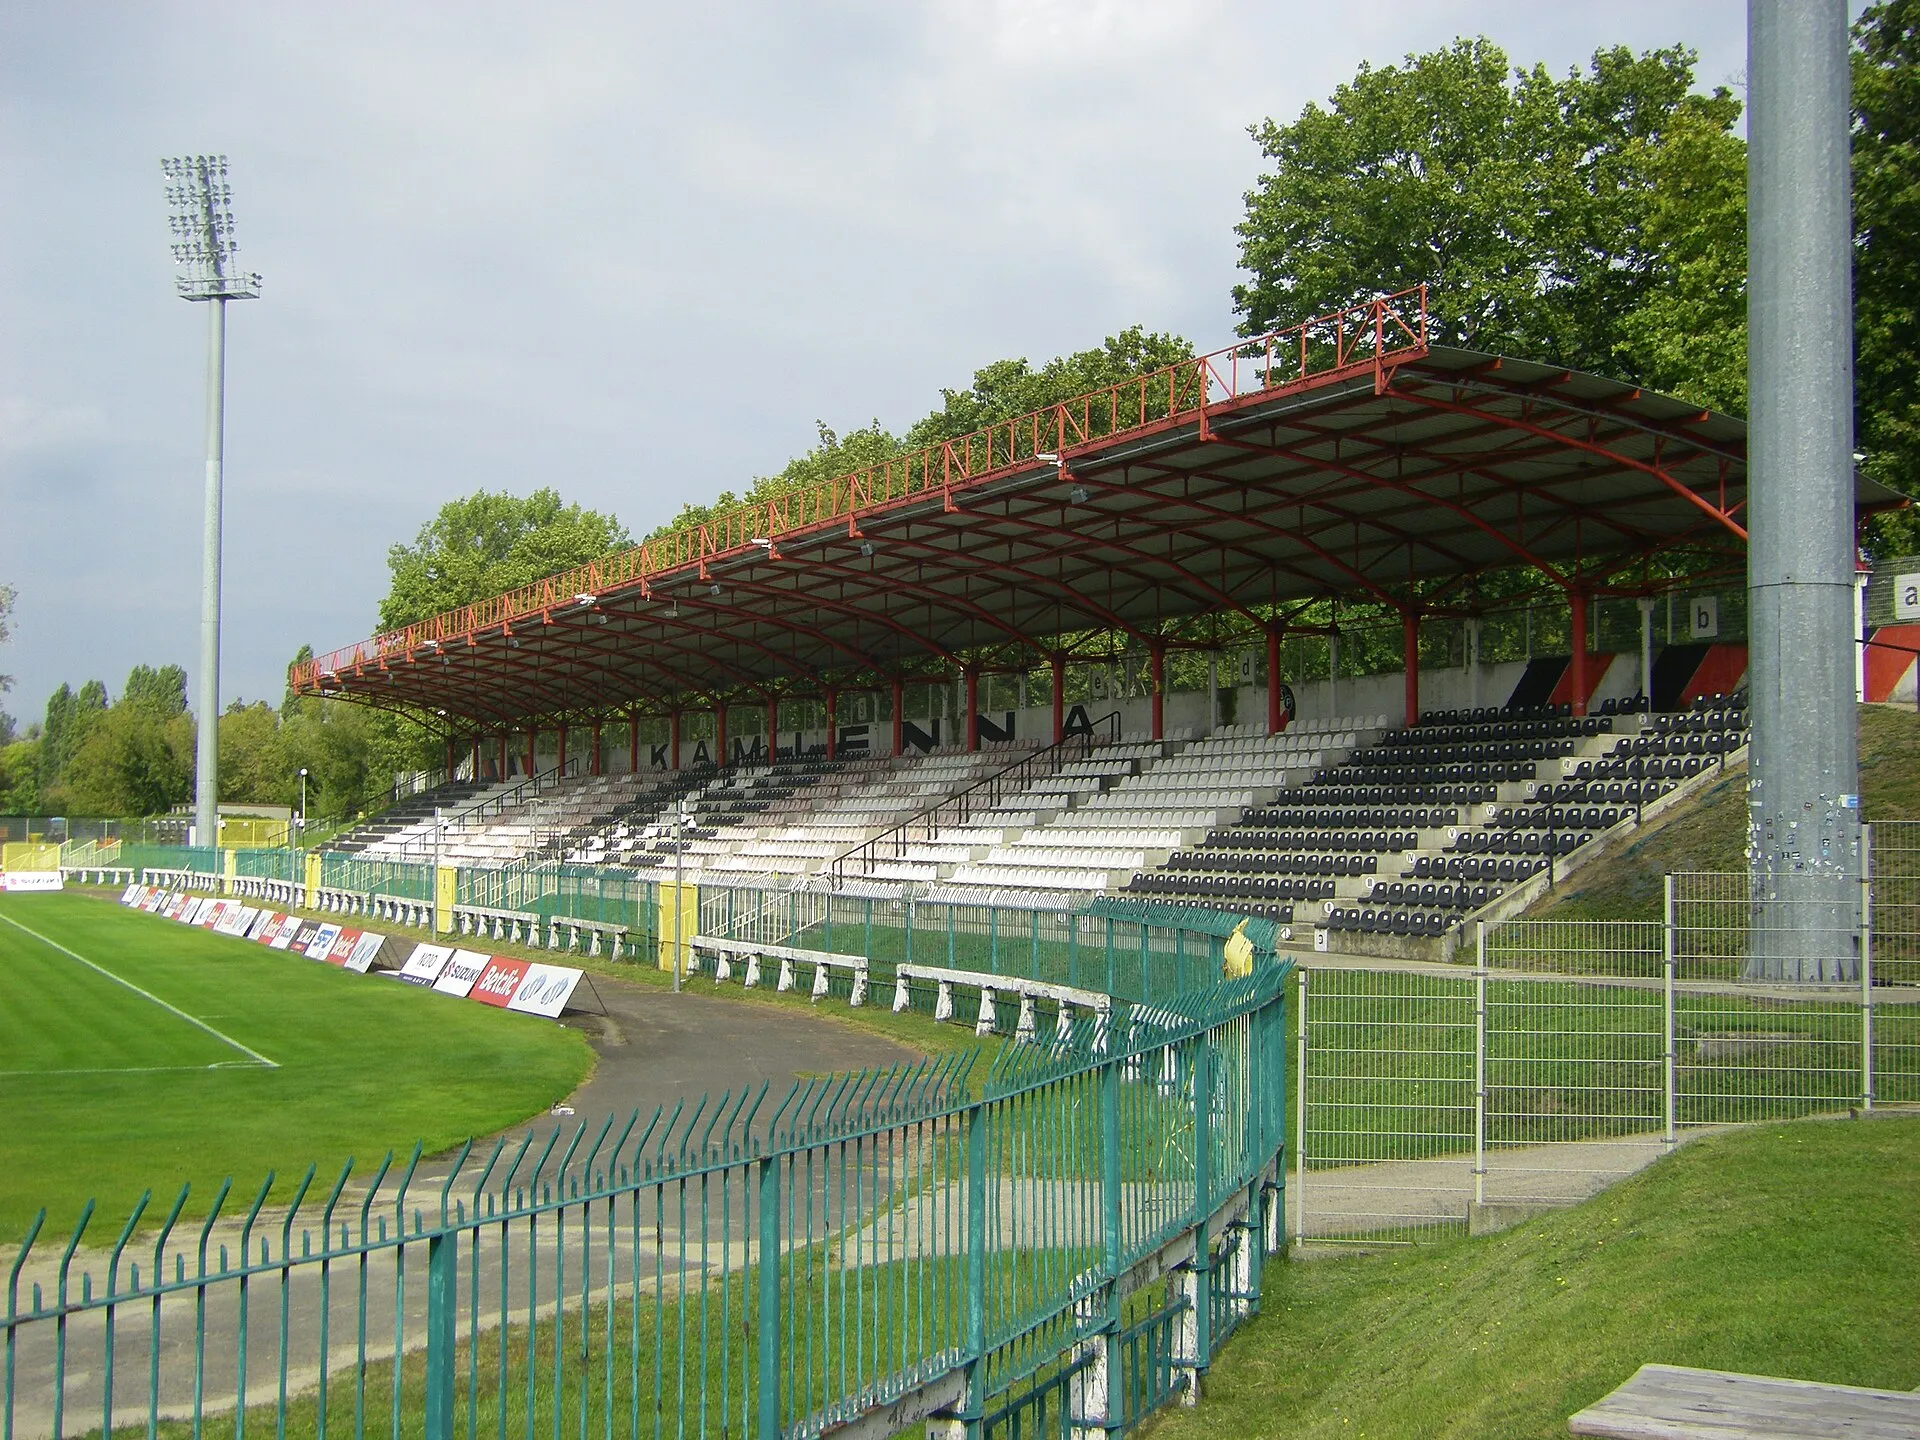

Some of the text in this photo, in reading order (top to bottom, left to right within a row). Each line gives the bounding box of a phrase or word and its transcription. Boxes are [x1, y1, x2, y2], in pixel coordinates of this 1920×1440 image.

[1904, 585, 1918, 607] a
[1697, 605, 1710, 629] b
[1241, 660, 1250, 676] d
[450, 964, 481, 983] SUZUKI
[478, 965, 519, 996] Betclic
